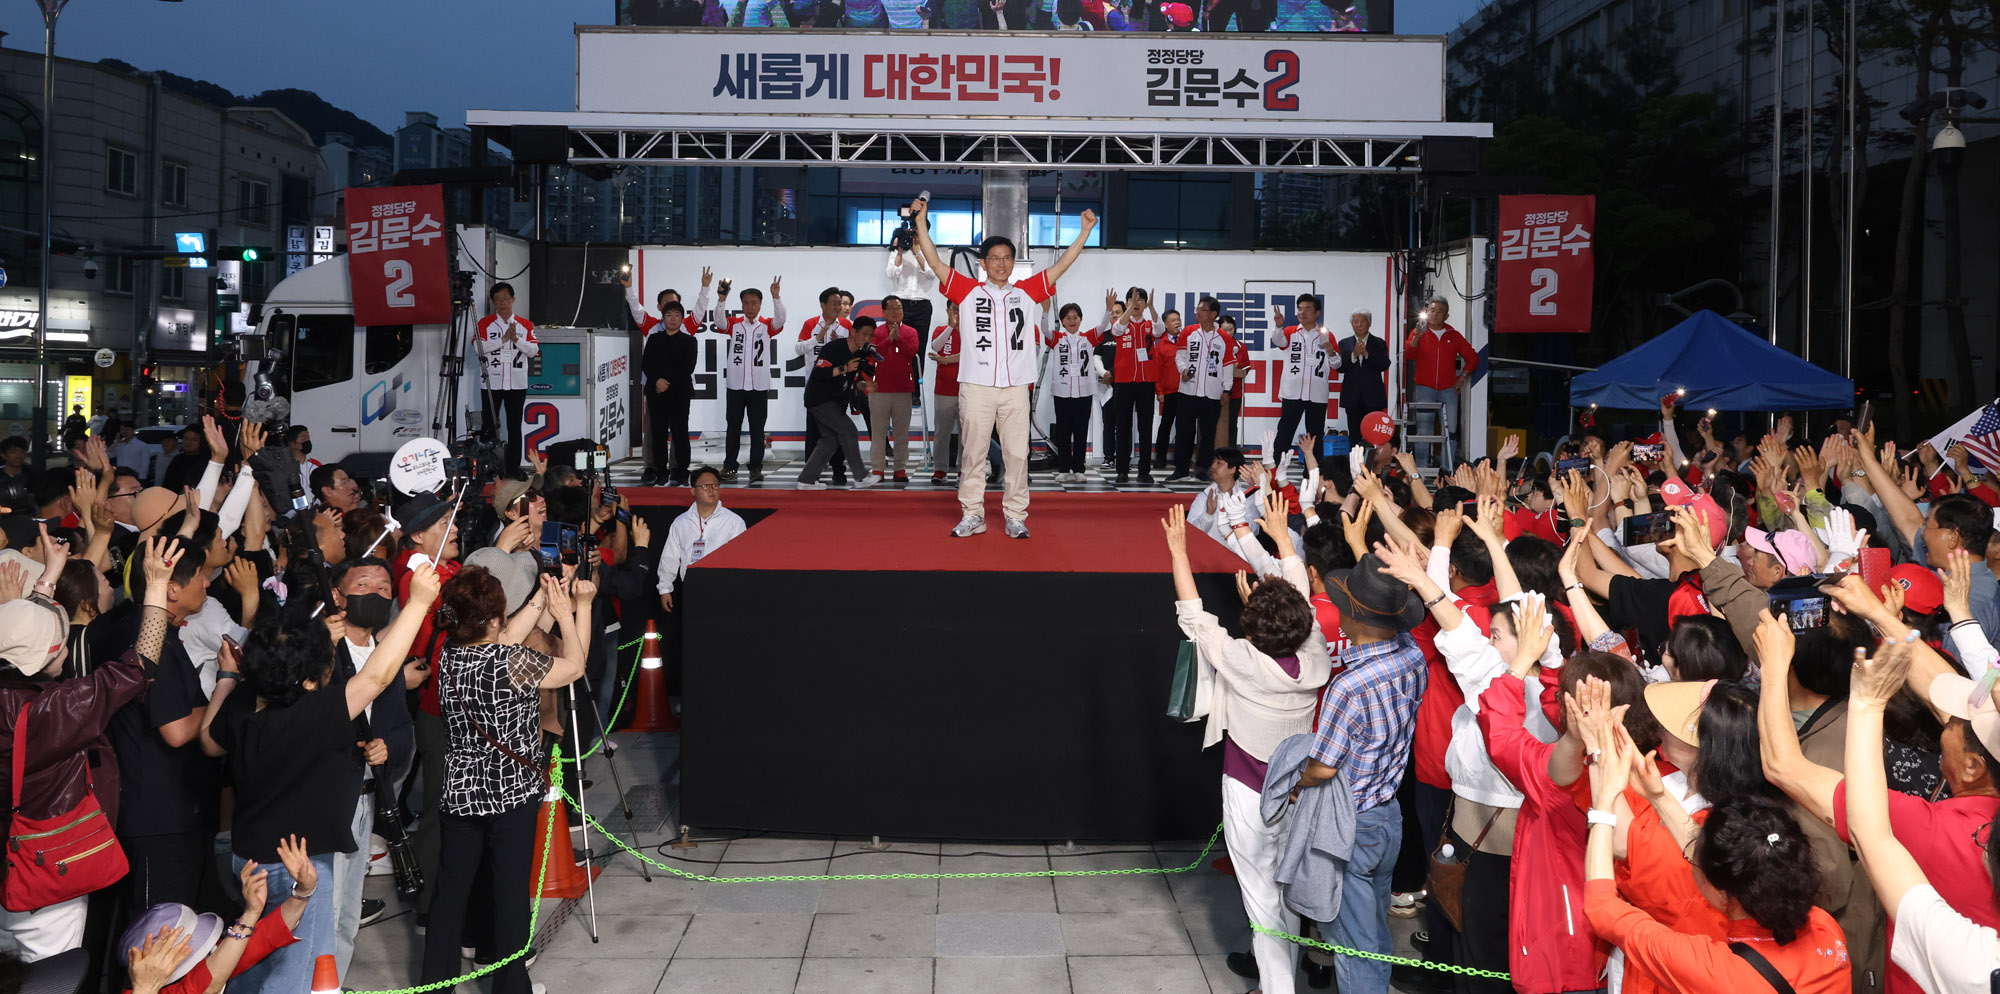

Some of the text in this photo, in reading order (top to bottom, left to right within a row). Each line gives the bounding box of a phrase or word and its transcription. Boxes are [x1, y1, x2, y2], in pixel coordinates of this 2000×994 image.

[1147, 48, 1205, 65] 정정당당
[713, 53, 1061, 102] 새롭게 대한민국!
[1146, 49, 1300, 112] 김문수 2
[371, 201, 417, 218] 정정당당
[1524, 210, 1569, 226] 정정당당
[350, 213, 442, 255] 김문수
[1501, 223, 1591, 261] 김문수
[384, 259, 416, 308] 2
[1529, 267, 1559, 316] 2
[975, 297, 992, 352] 김문수
[1009, 307, 1025, 351] 2
[733, 331, 744, 366] 김문수
[754, 339, 764, 367] 2
[1059, 343, 1069, 378] 김문수
[1080, 349, 1089, 377] 2
[1290, 341, 1302, 376] 김문수
[1314, 350, 1325, 378] 2
[524, 402, 559, 463] 2
[600, 397, 625, 445] 김문수
[397, 448, 440, 473] 온기나눔
